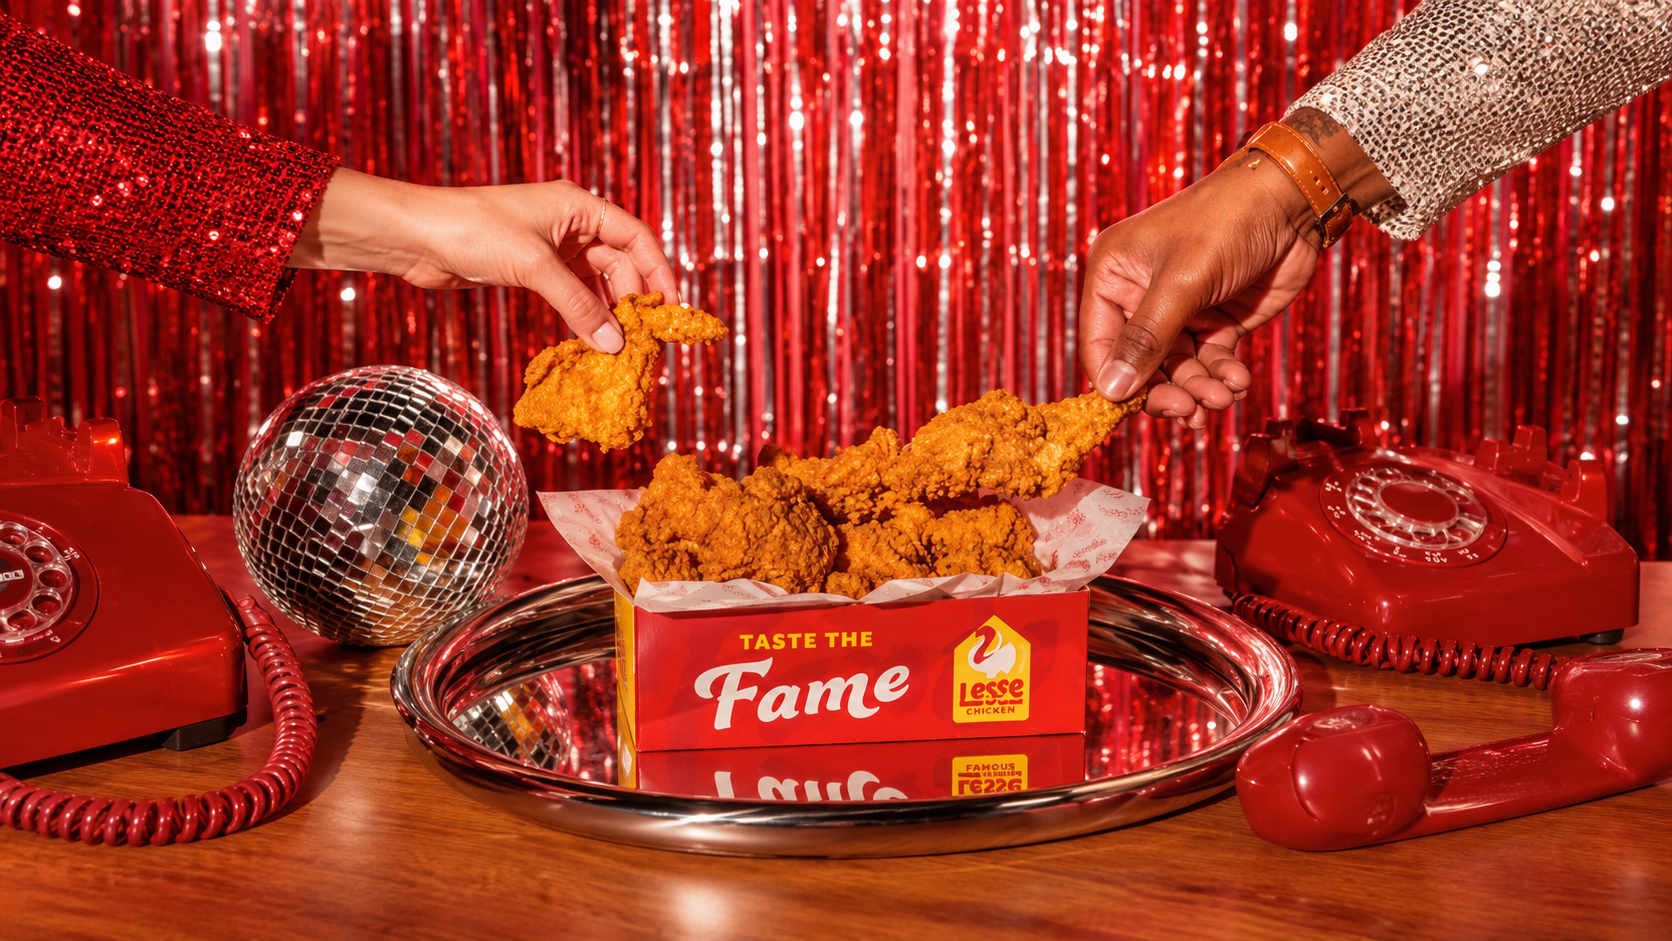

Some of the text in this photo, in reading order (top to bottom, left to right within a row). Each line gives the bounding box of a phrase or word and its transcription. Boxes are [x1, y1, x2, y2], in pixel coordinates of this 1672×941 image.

[739, 631, 873, 650] TASTE THE
[694, 656, 910, 730] Fame
[959, 679, 1024, 707] Lesse
[966, 706, 1015, 715] CHICKEN
[966, 762, 1015, 772] FAMOUS
